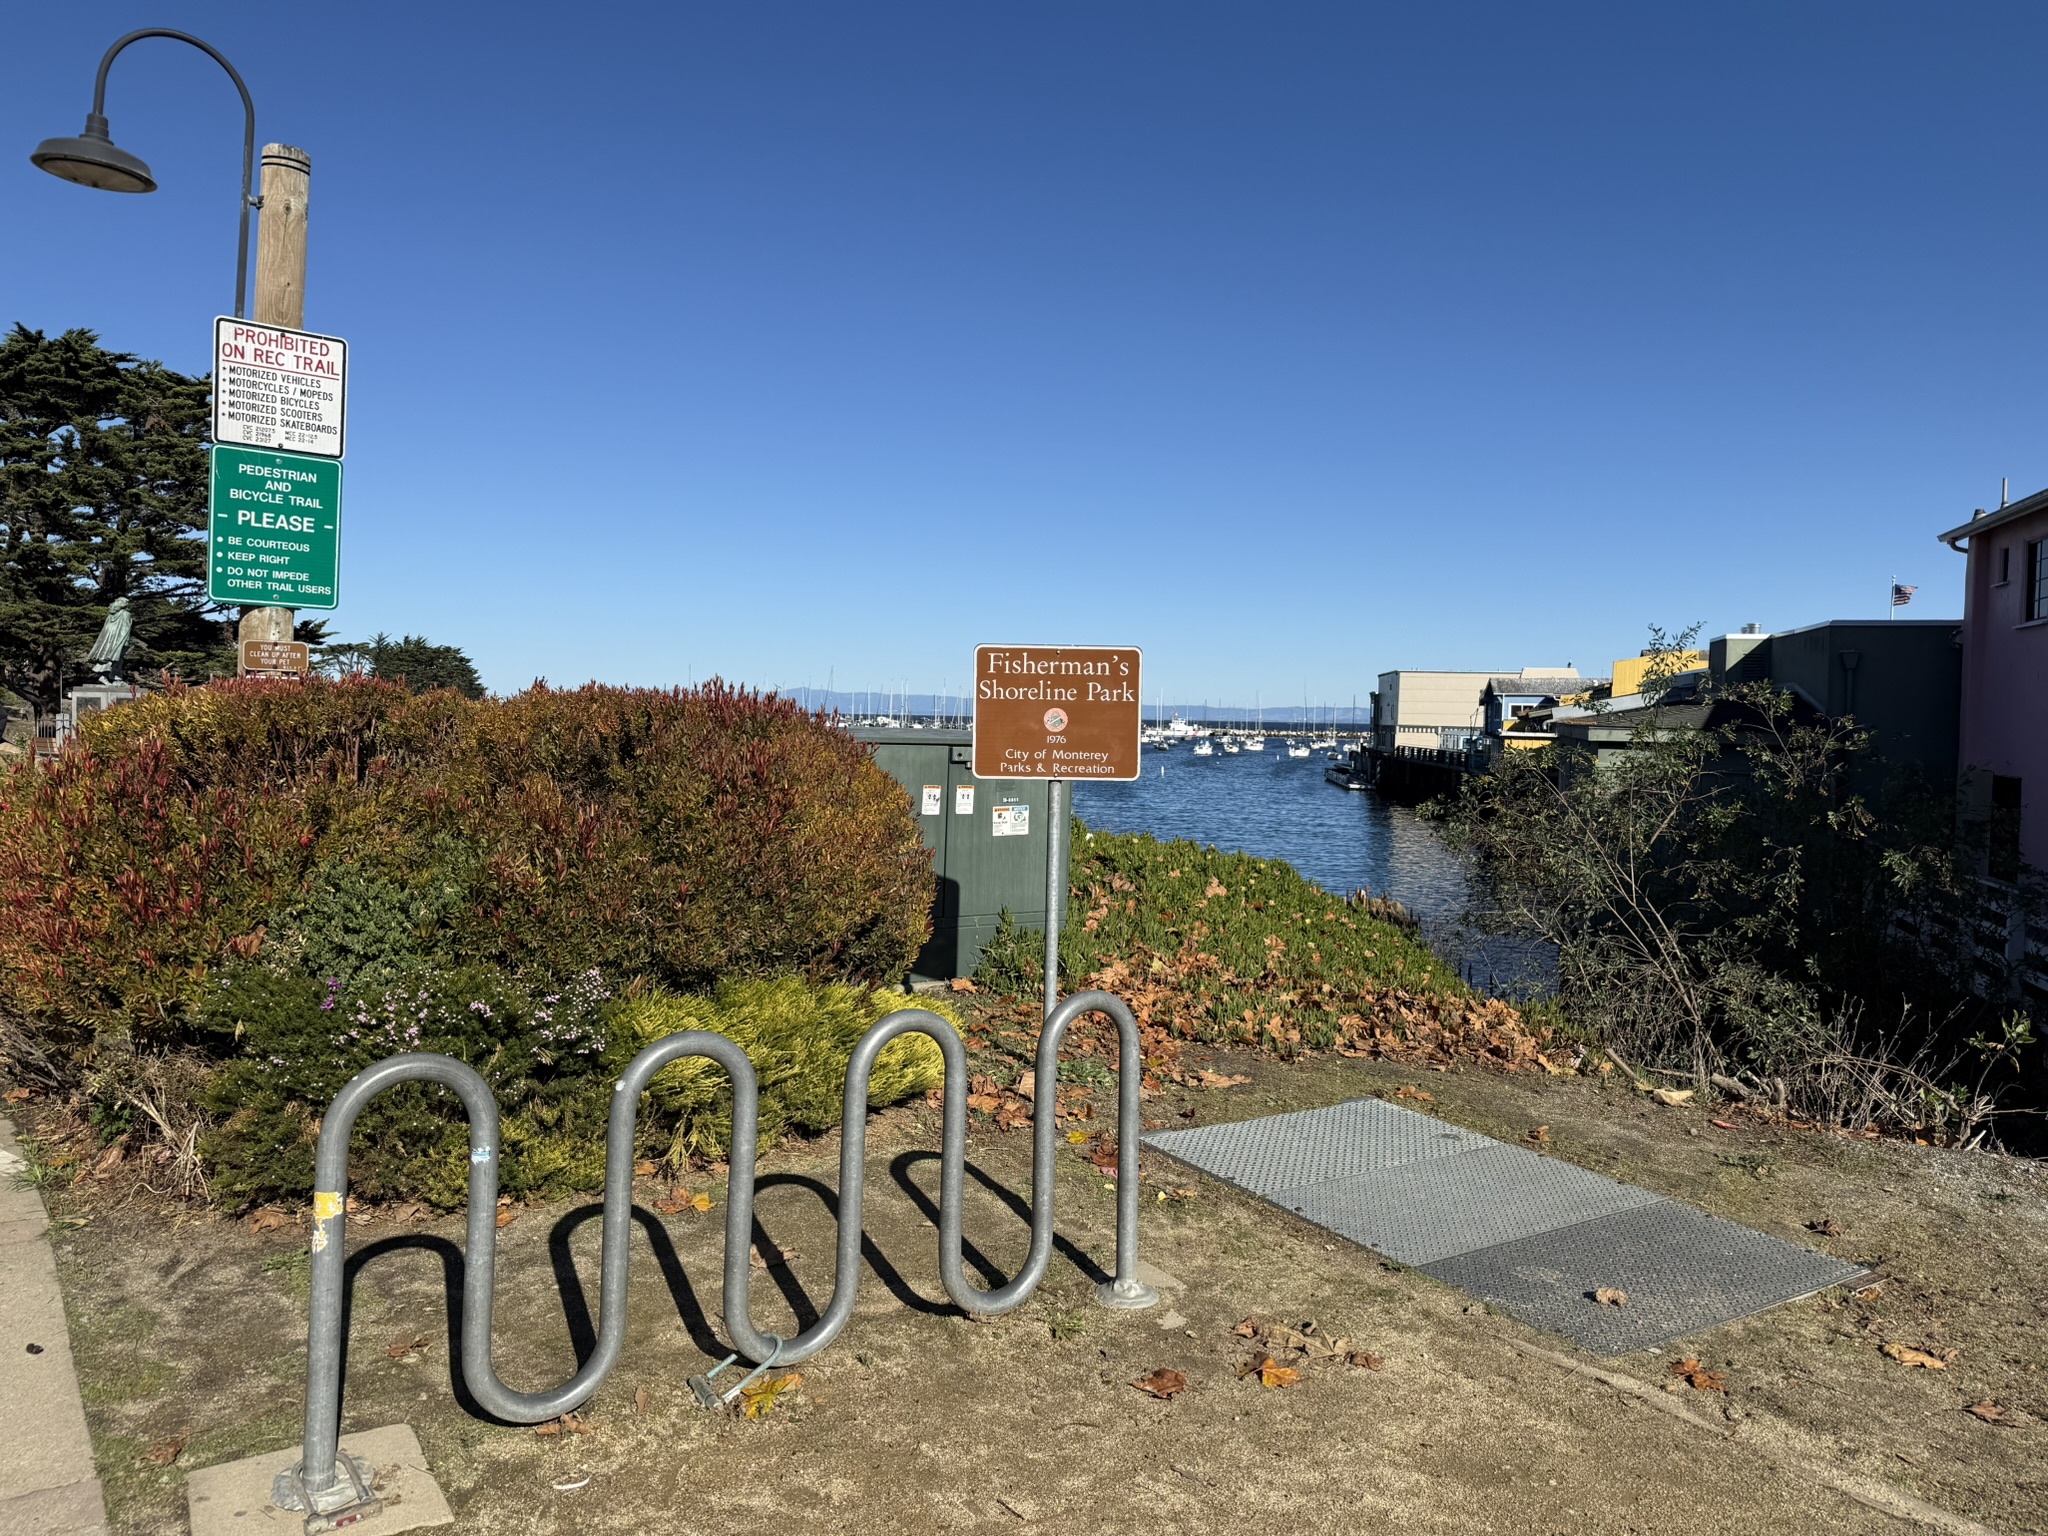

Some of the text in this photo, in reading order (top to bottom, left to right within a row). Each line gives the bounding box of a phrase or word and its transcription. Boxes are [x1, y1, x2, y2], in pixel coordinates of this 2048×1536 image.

[234, 327, 329, 356] PROHIBITED
[222, 343, 339, 376] ON REC TRAIL
[229, 366, 321, 388] MOTORIZED VEHICLES
[229, 378, 289, 394] MOTORCYCLES
[300, 389, 333, 401] MOPEDS
[229, 389, 319, 410] MOTORIZED BICYCLES
[228, 400, 322, 422] MOTORIZED SCOOTERS
[228, 412, 337, 434] MOTORIZED SKATEBOARDS
[239, 464, 317, 483] PEDESTRIAN
[265, 481, 291, 492] AND
[230, 488, 323, 509] BICYCLE TRAIL
[238, 510, 315, 533] PLEASE
[228, 537, 310, 552] BE COURTEOUS
[228, 552, 290, 565] KEEP RIGHT
[228, 567, 309, 581] DO NOT IMPEDE
[227, 580, 331, 595] OTHER TRAIL USERS
[988, 652, 1129, 676] Fisherman's
[979, 680, 1135, 702] Shoreline Park
[1047, 736, 1066, 744] 1976
[1006, 749, 1108, 762] City of Monterey
[1000, 763, 1031, 772] Parks
[1053, 764, 1114, 773] Recreation
